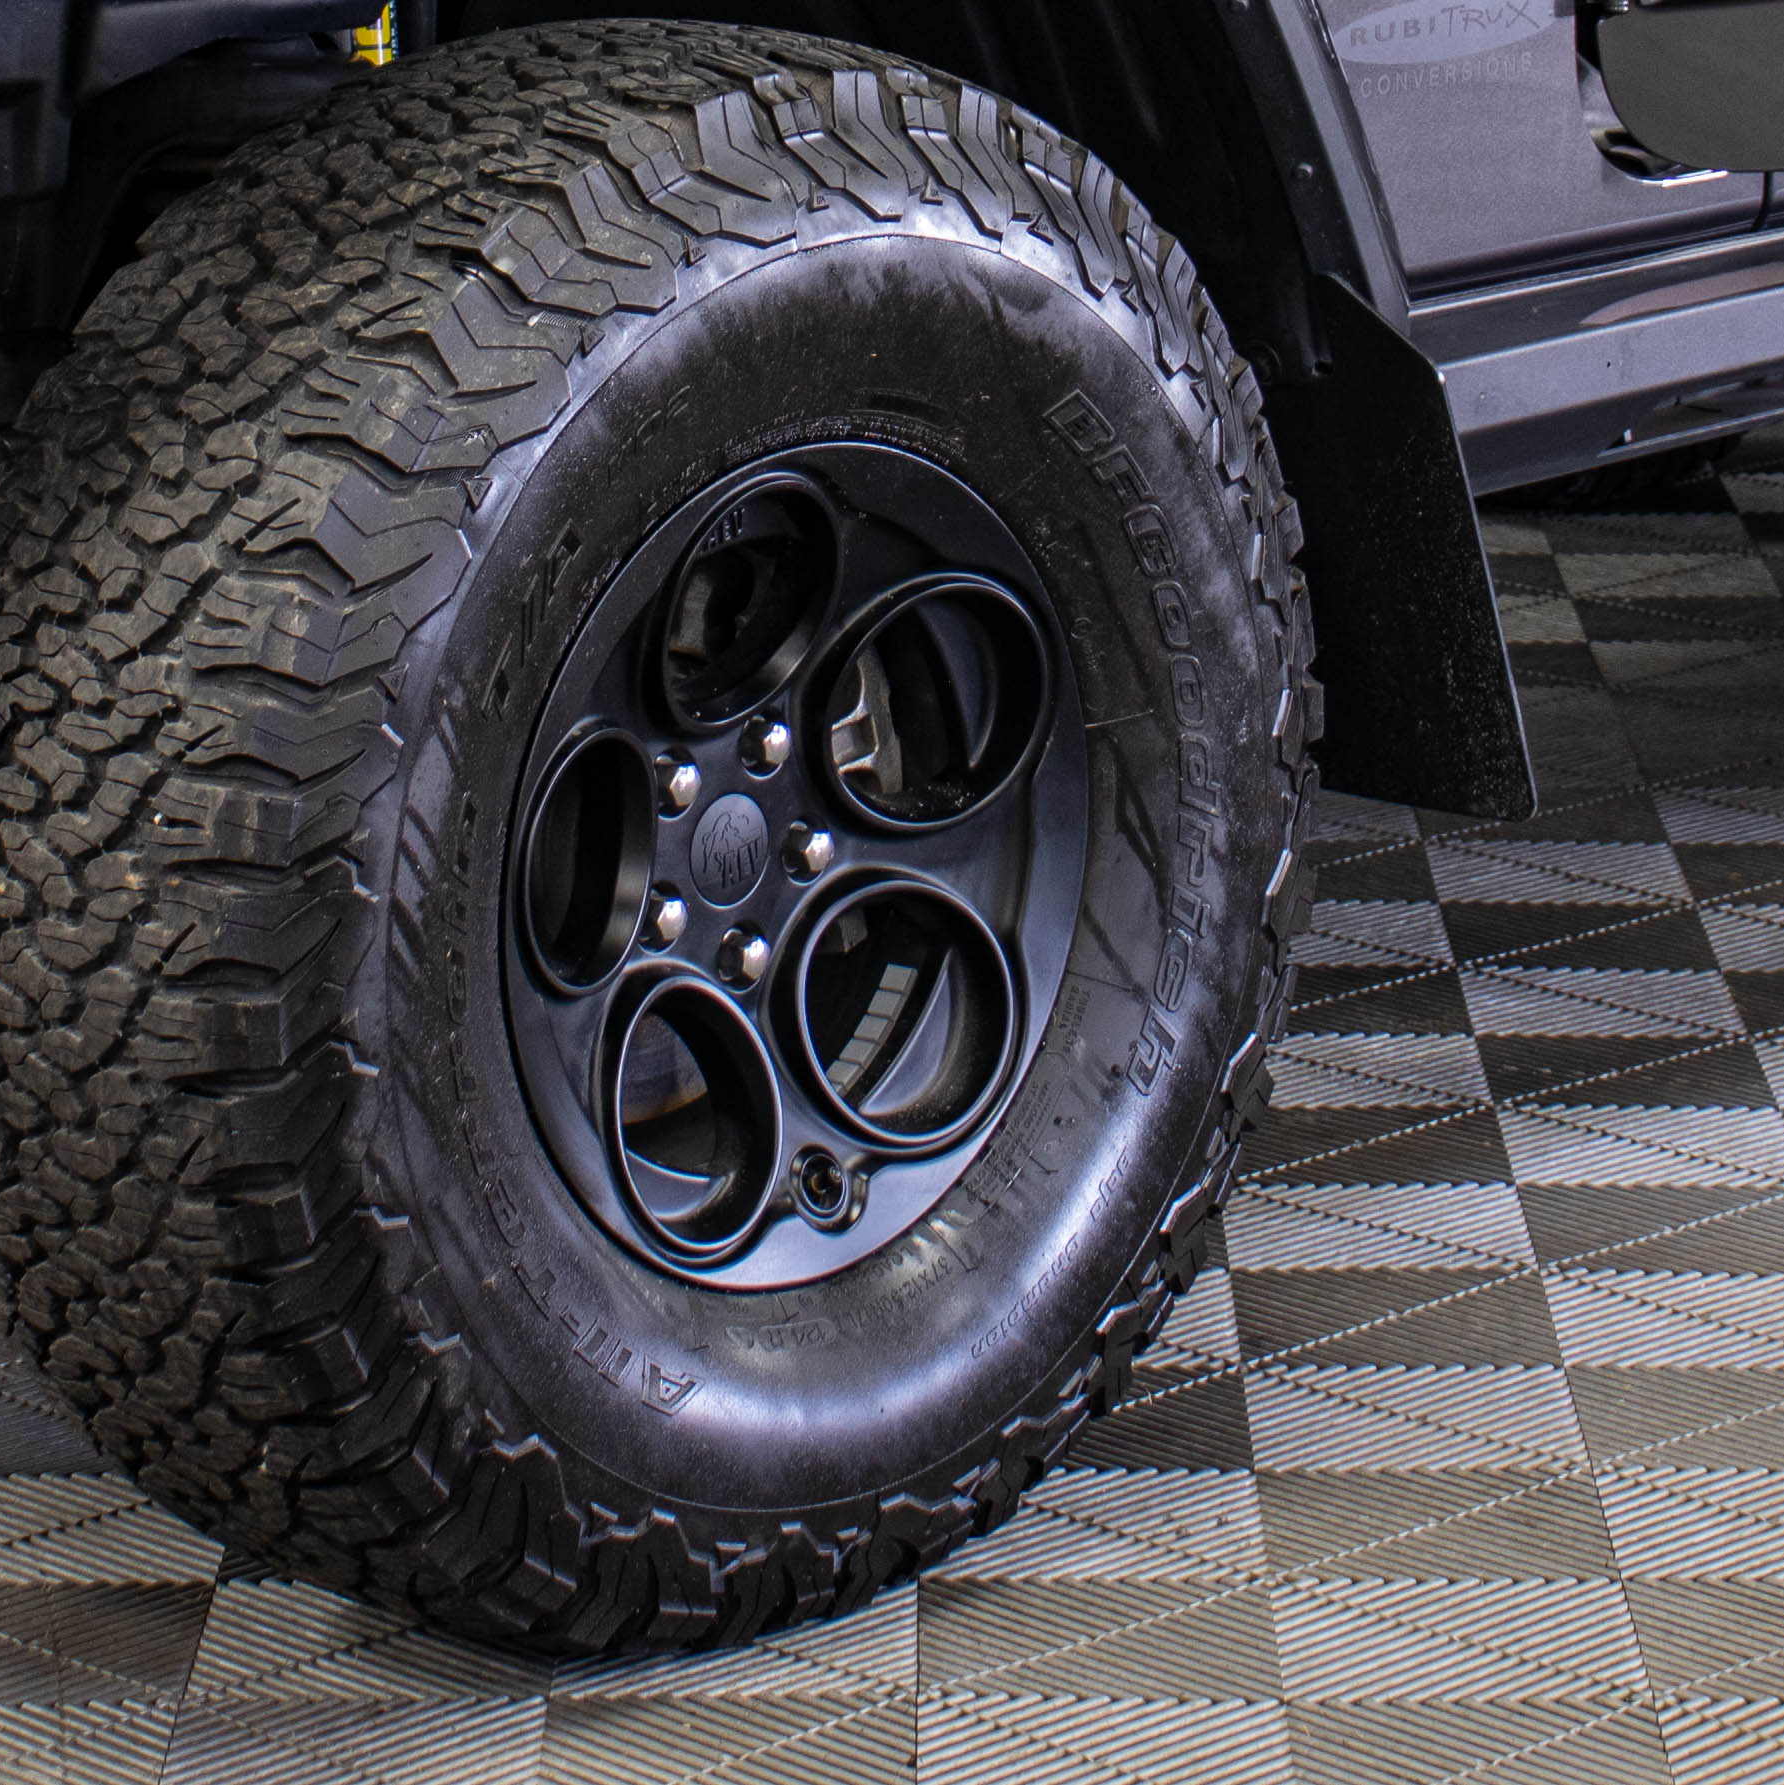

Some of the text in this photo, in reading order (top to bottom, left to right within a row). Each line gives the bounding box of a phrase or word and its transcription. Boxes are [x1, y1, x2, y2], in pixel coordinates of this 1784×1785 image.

[1359, 51, 1534, 98] CONVERSIONS
[1041, 388, 1221, 1097] BFGoodrich
[1088, 1145, 1131, 1223] Baja
[970, 1232, 1079, 1360] Champion
